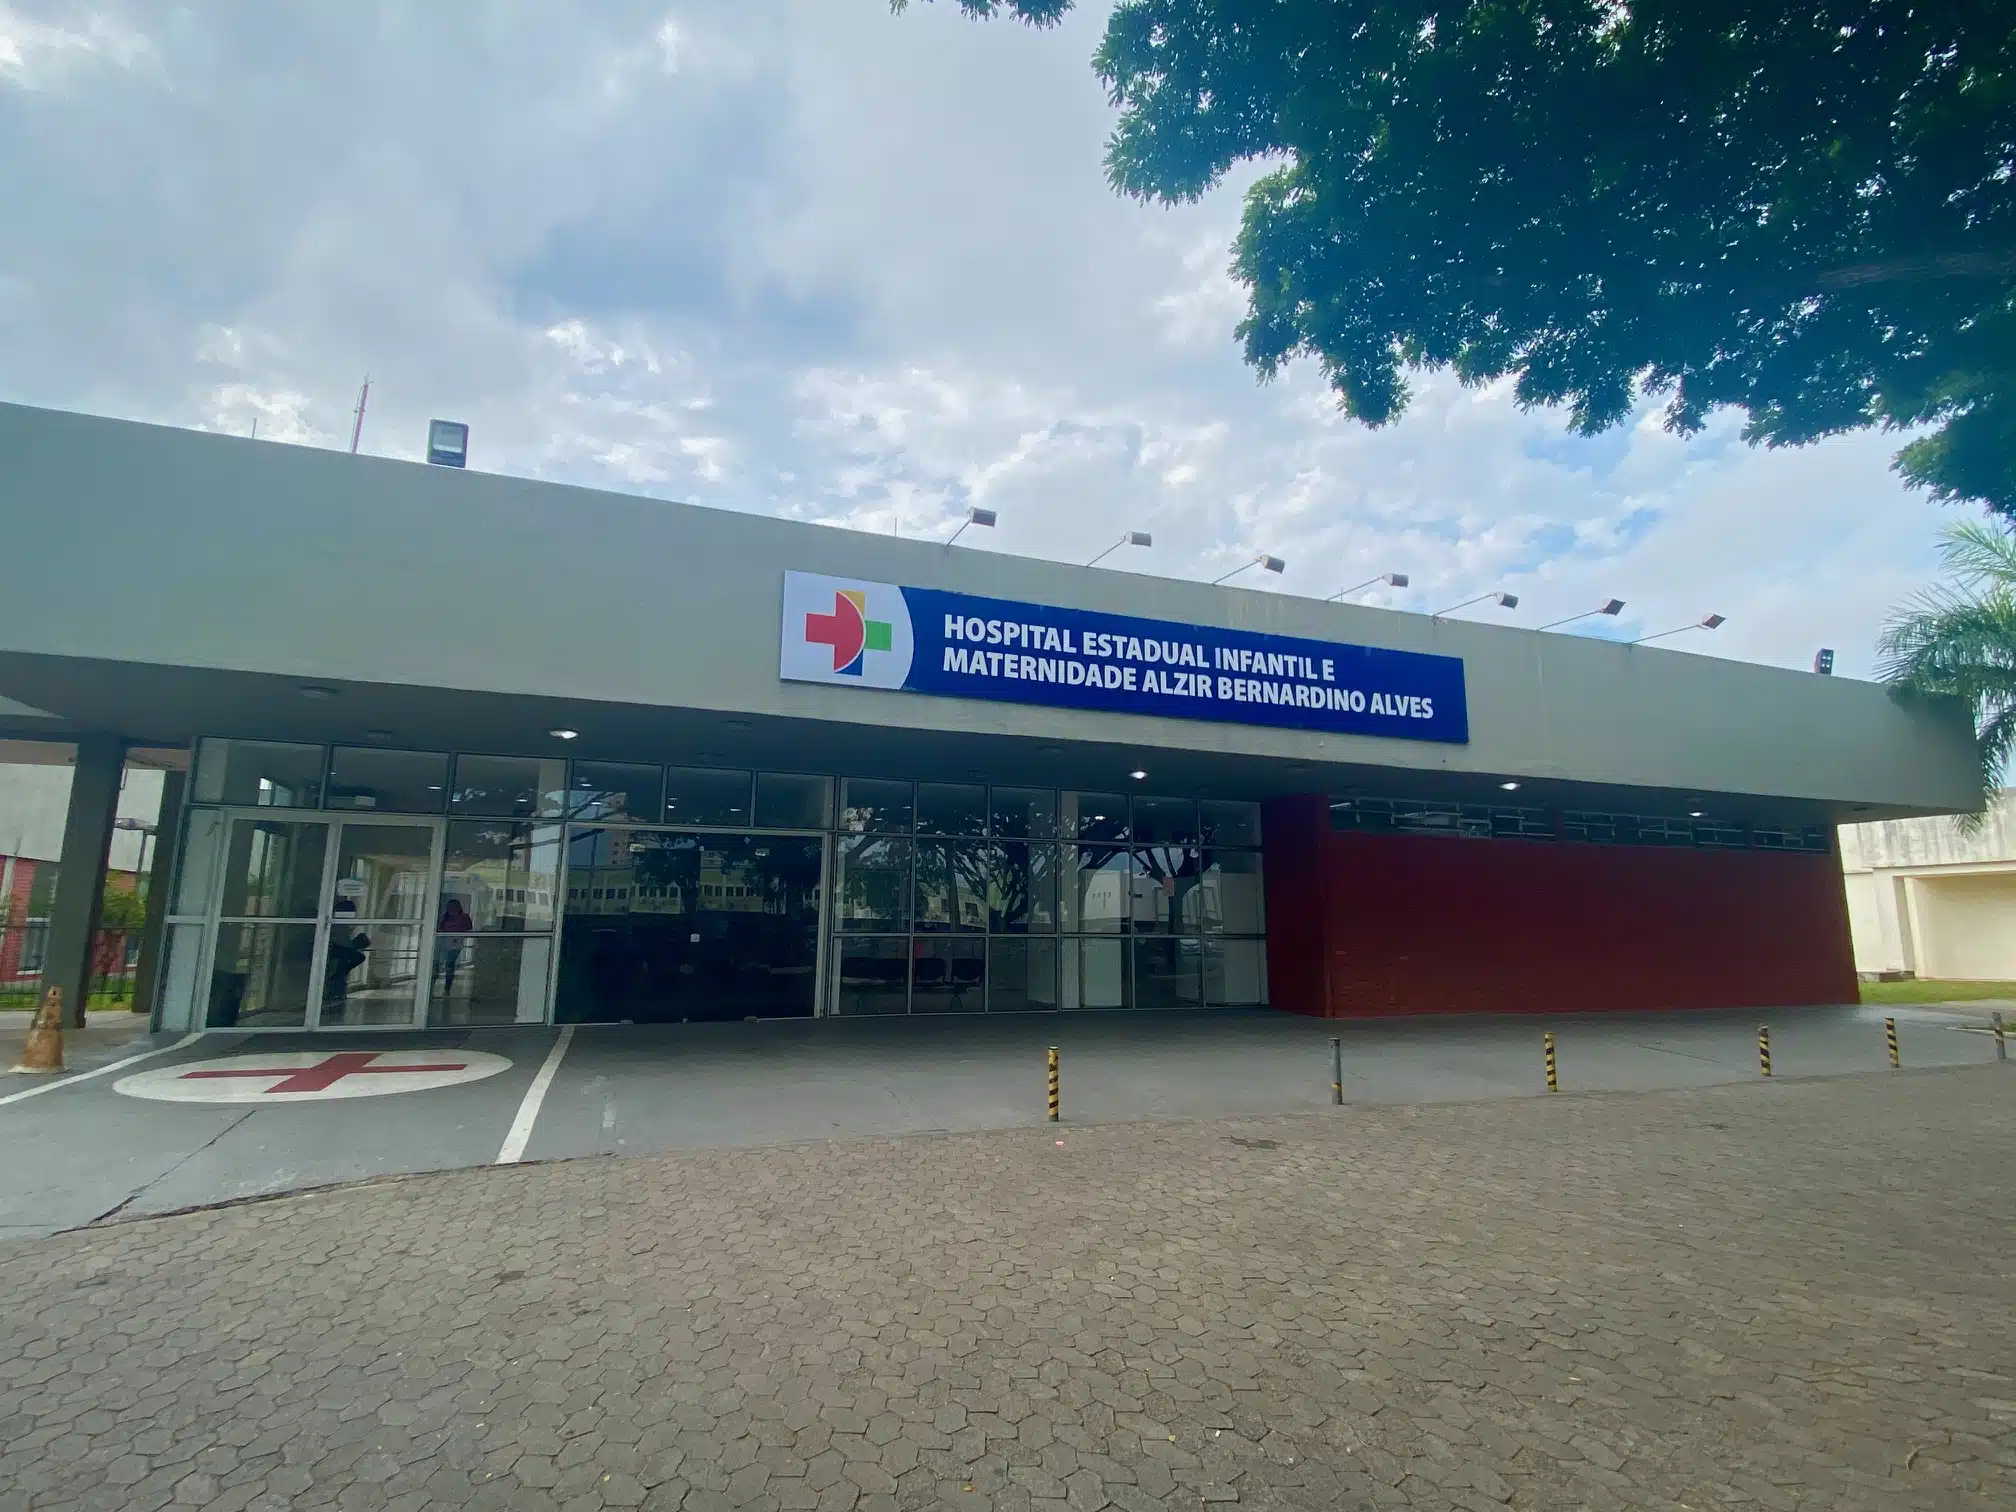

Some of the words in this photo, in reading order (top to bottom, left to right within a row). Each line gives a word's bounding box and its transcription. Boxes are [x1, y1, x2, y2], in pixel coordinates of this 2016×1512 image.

[943, 613, 1077, 654] HOSPITAL
[1083, 631, 1210, 668] ESTADUAL
[1214, 647, 1318, 680] INFANTIL
[1322, 659, 1335, 681] E
[943, 646, 1137, 691] MATERNIDADE
[1142, 669, 1213, 698] ALZIR
[1217, 676, 1366, 713] BERNARDINO
[1370, 692, 1434, 719] ALVES
